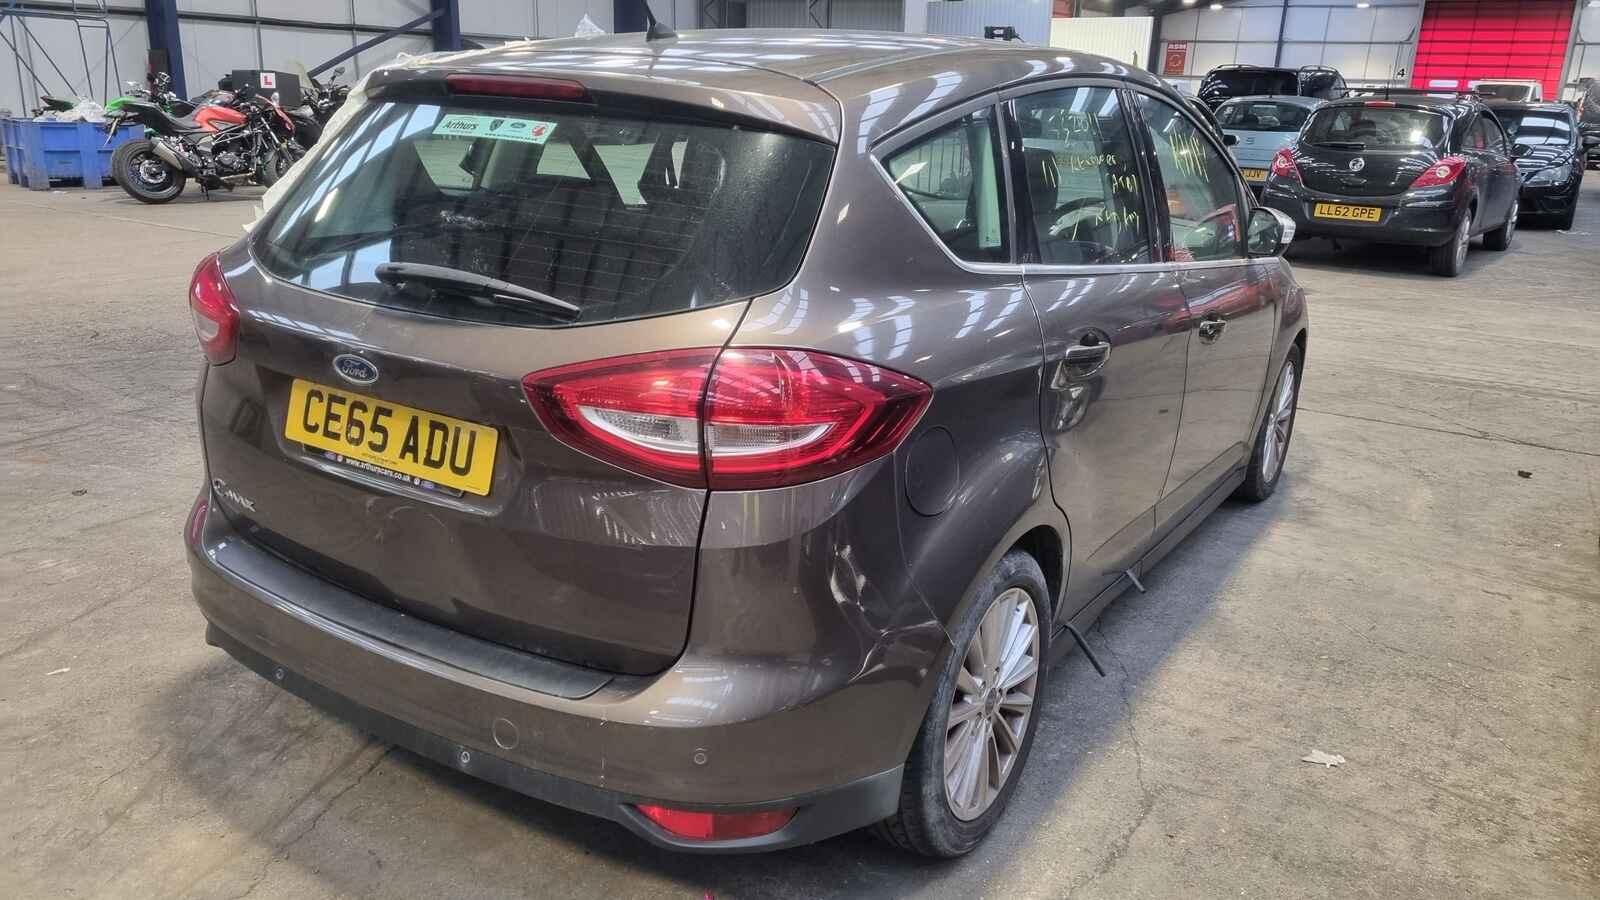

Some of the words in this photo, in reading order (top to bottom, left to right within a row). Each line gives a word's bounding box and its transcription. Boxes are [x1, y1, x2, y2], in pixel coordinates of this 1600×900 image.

[1397, 68, 1405, 77] 4
[263, 75, 273, 86] L
[443, 120, 479, 130] Arthurs
[1320, 205, 1348, 217] LL62
[1352, 207, 1376, 219] GPE
[342, 359, 368, 379] Ford
[302, 389, 393, 453] CE65
[400, 415, 477, 477] ADU
